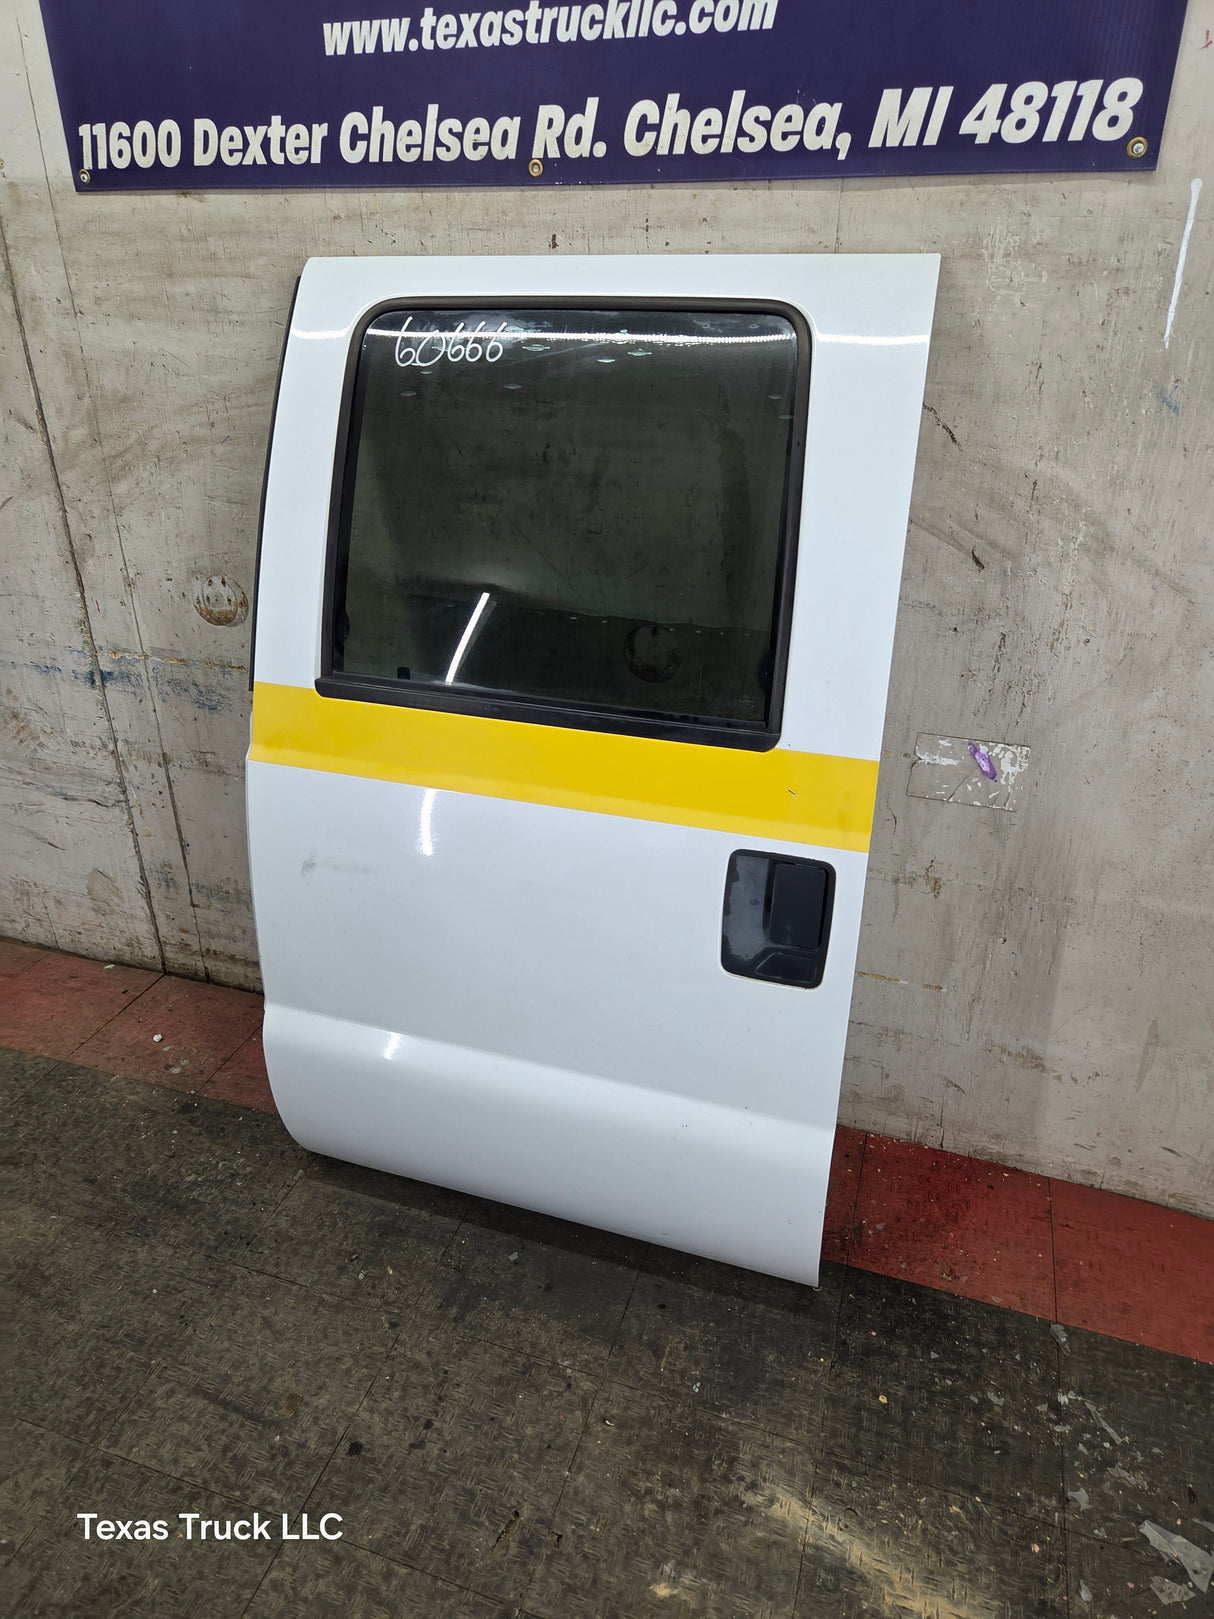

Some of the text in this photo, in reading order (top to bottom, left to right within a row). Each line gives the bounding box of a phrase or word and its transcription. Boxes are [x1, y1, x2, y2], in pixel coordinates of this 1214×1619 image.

[323, 0, 778, 56] www.texastruckllc.com
[79, 78, 1144, 169] 11600 Dexter Chelsea Rd. Chelsea, MI 48118
[395, 316, 507, 367] 60666
